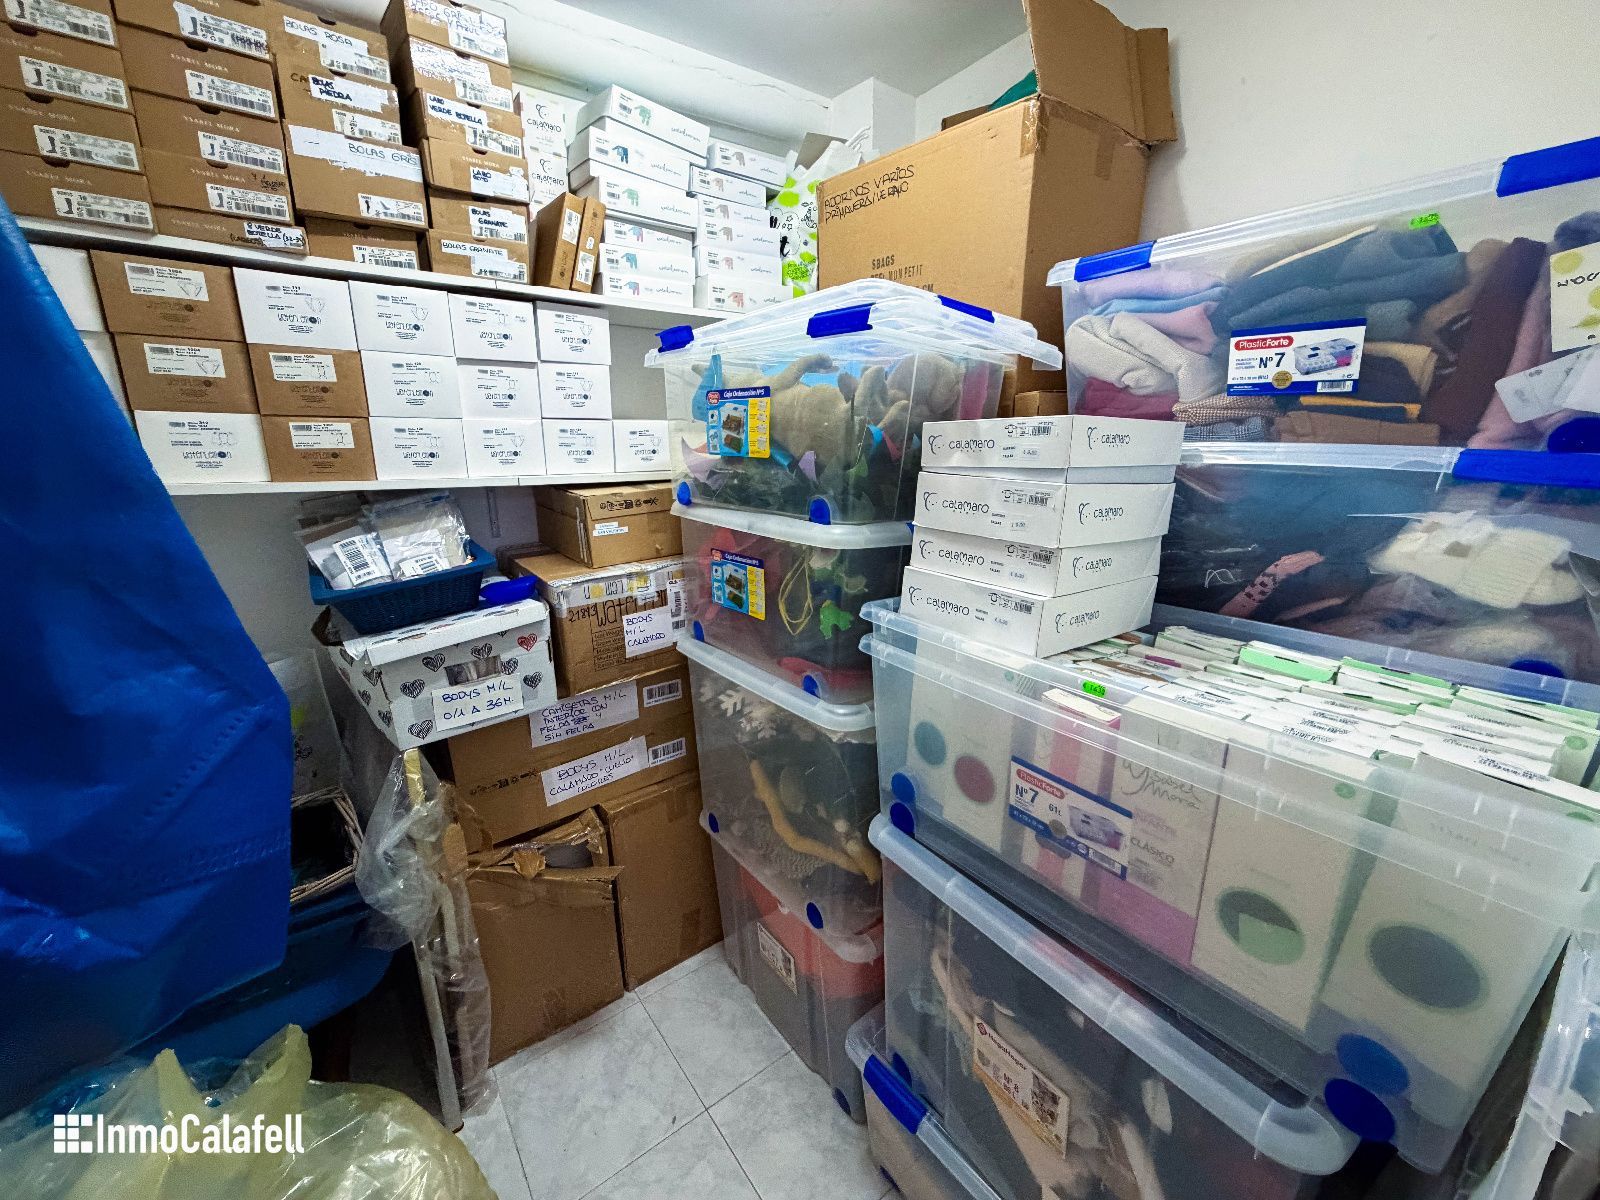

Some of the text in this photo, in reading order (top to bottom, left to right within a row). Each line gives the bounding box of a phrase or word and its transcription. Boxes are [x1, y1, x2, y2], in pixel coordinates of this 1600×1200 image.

[285, 19, 353, 47] BOLAS ROSA
[318, 87, 353, 102] PIEDRA
[348, 142, 419, 166] BOLAS GRIS
[442, 242, 467, 251] BOLAS
[904, 264, 923, 279] PETIT
[1239, 337, 1290, 350] PlasticForte
[1274, 351, 1286, 368] 7
[948, 438, 995, 450] calamaro
[1100, 432, 1131, 446] calamaro
[941, 498, 990, 514] calamaro
[1093, 506, 1124, 519] calamaro
[938, 548, 985, 566] calamaro
[1085, 557, 1113, 571] calamaro
[926, 594, 970, 616] calamaro
[1069, 610, 1100, 626] calamaro
[442, 688, 481, 703] BODYS
[541, 696, 599, 718] CAMISETAS
[565, 722, 595, 737] FELPA
[557, 759, 597, 781] BODYS
[1028, 786, 1039, 804] 7
